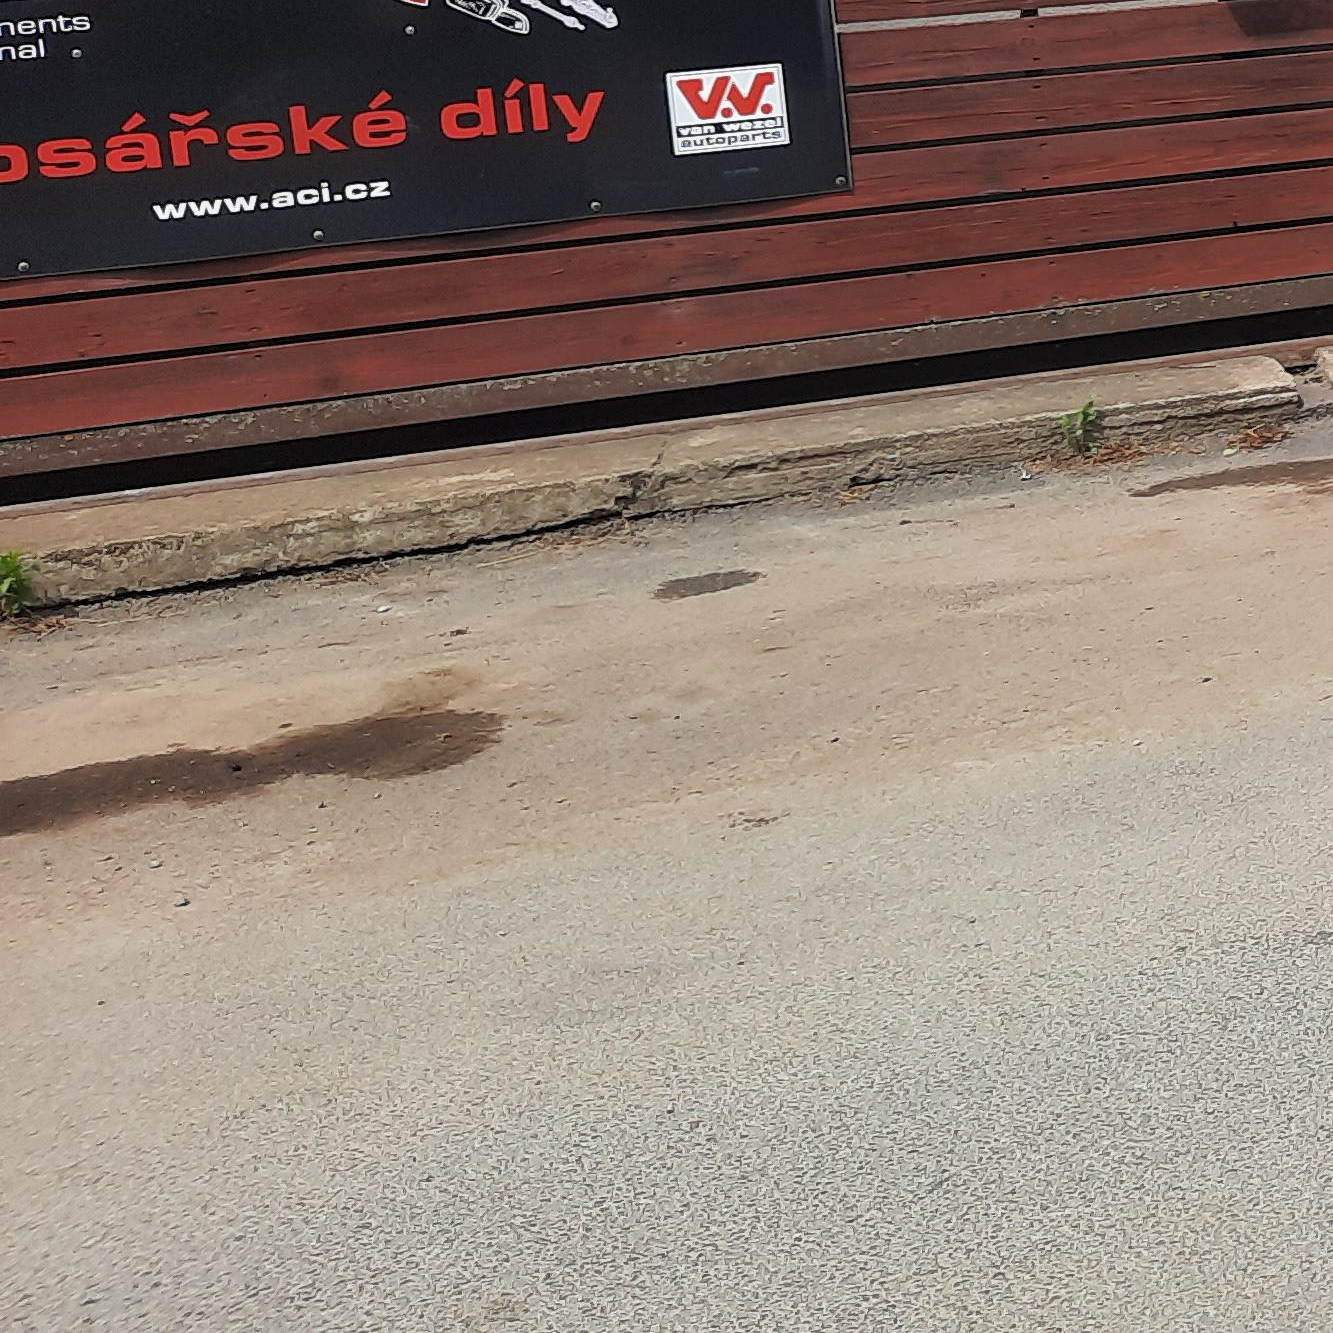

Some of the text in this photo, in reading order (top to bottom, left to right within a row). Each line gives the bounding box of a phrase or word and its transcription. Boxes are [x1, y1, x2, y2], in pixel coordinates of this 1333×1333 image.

[440, 77, 605, 143] díly
[681, 130, 782, 148] autoparts
[721, 117, 782, 133] wezel
[152, 180, 392, 221] www.aci.cz
